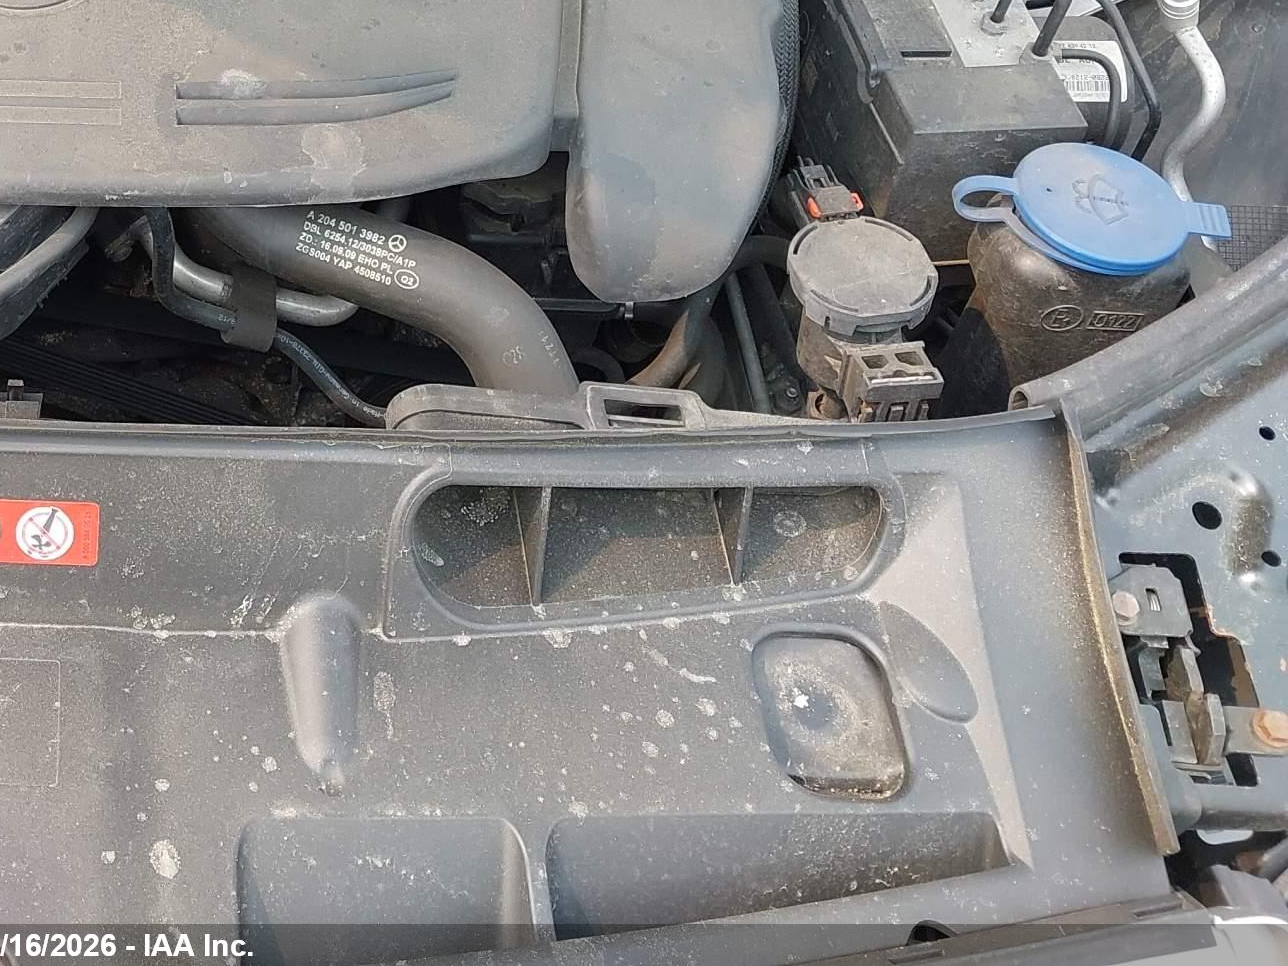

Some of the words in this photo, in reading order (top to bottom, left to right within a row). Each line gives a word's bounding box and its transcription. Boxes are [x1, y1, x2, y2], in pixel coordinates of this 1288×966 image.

[304, 221, 322, 235] DBL
[306, 210, 314, 220] A
[318, 214, 336, 228] 204
[338, 221, 358, 234] 501
[360, 228, 386, 245] 3982
[296, 242, 330, 262] ZGS004
[332, 256, 352, 270] YAP
[354, 266, 392, 286] 4508510
[358, 254, 379, 268] EHO
[380, 262, 393, 274] PL
